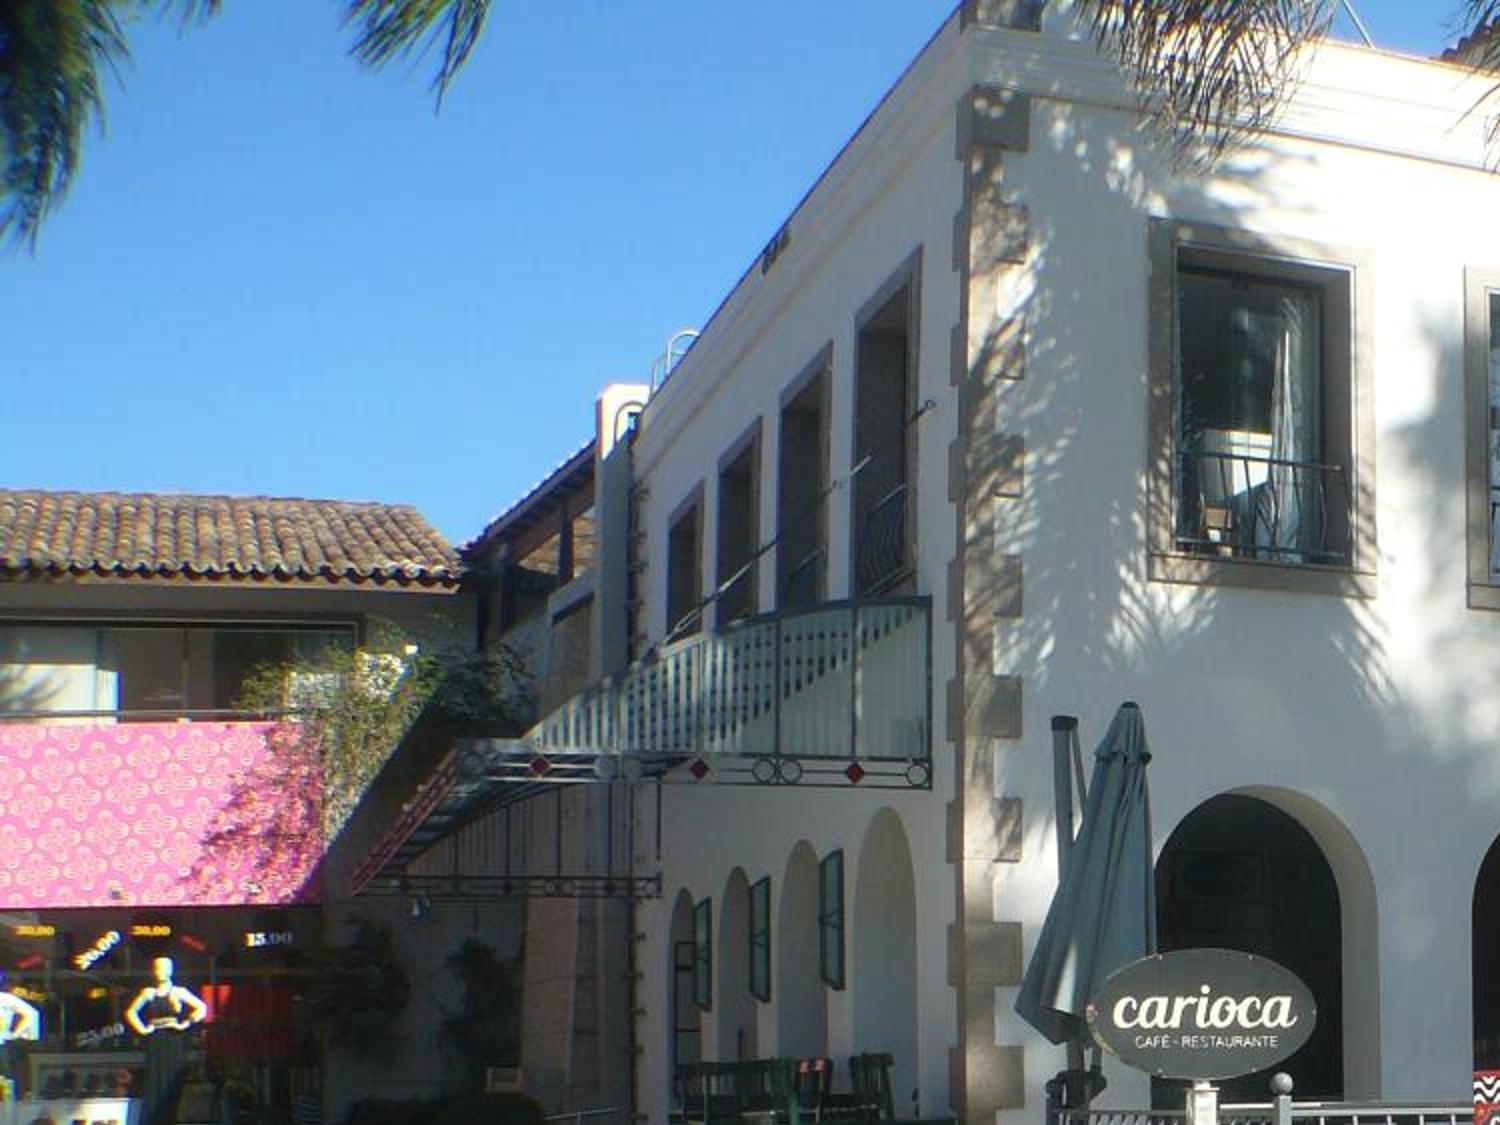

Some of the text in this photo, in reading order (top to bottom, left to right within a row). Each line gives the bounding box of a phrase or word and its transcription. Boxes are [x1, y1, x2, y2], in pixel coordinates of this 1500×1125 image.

[1113, 984, 1298, 1029] carioca
[1135, 1034, 1170, 1049] CAFÉ
[1181, 1034, 1279, 1049] RESTAURANTE
